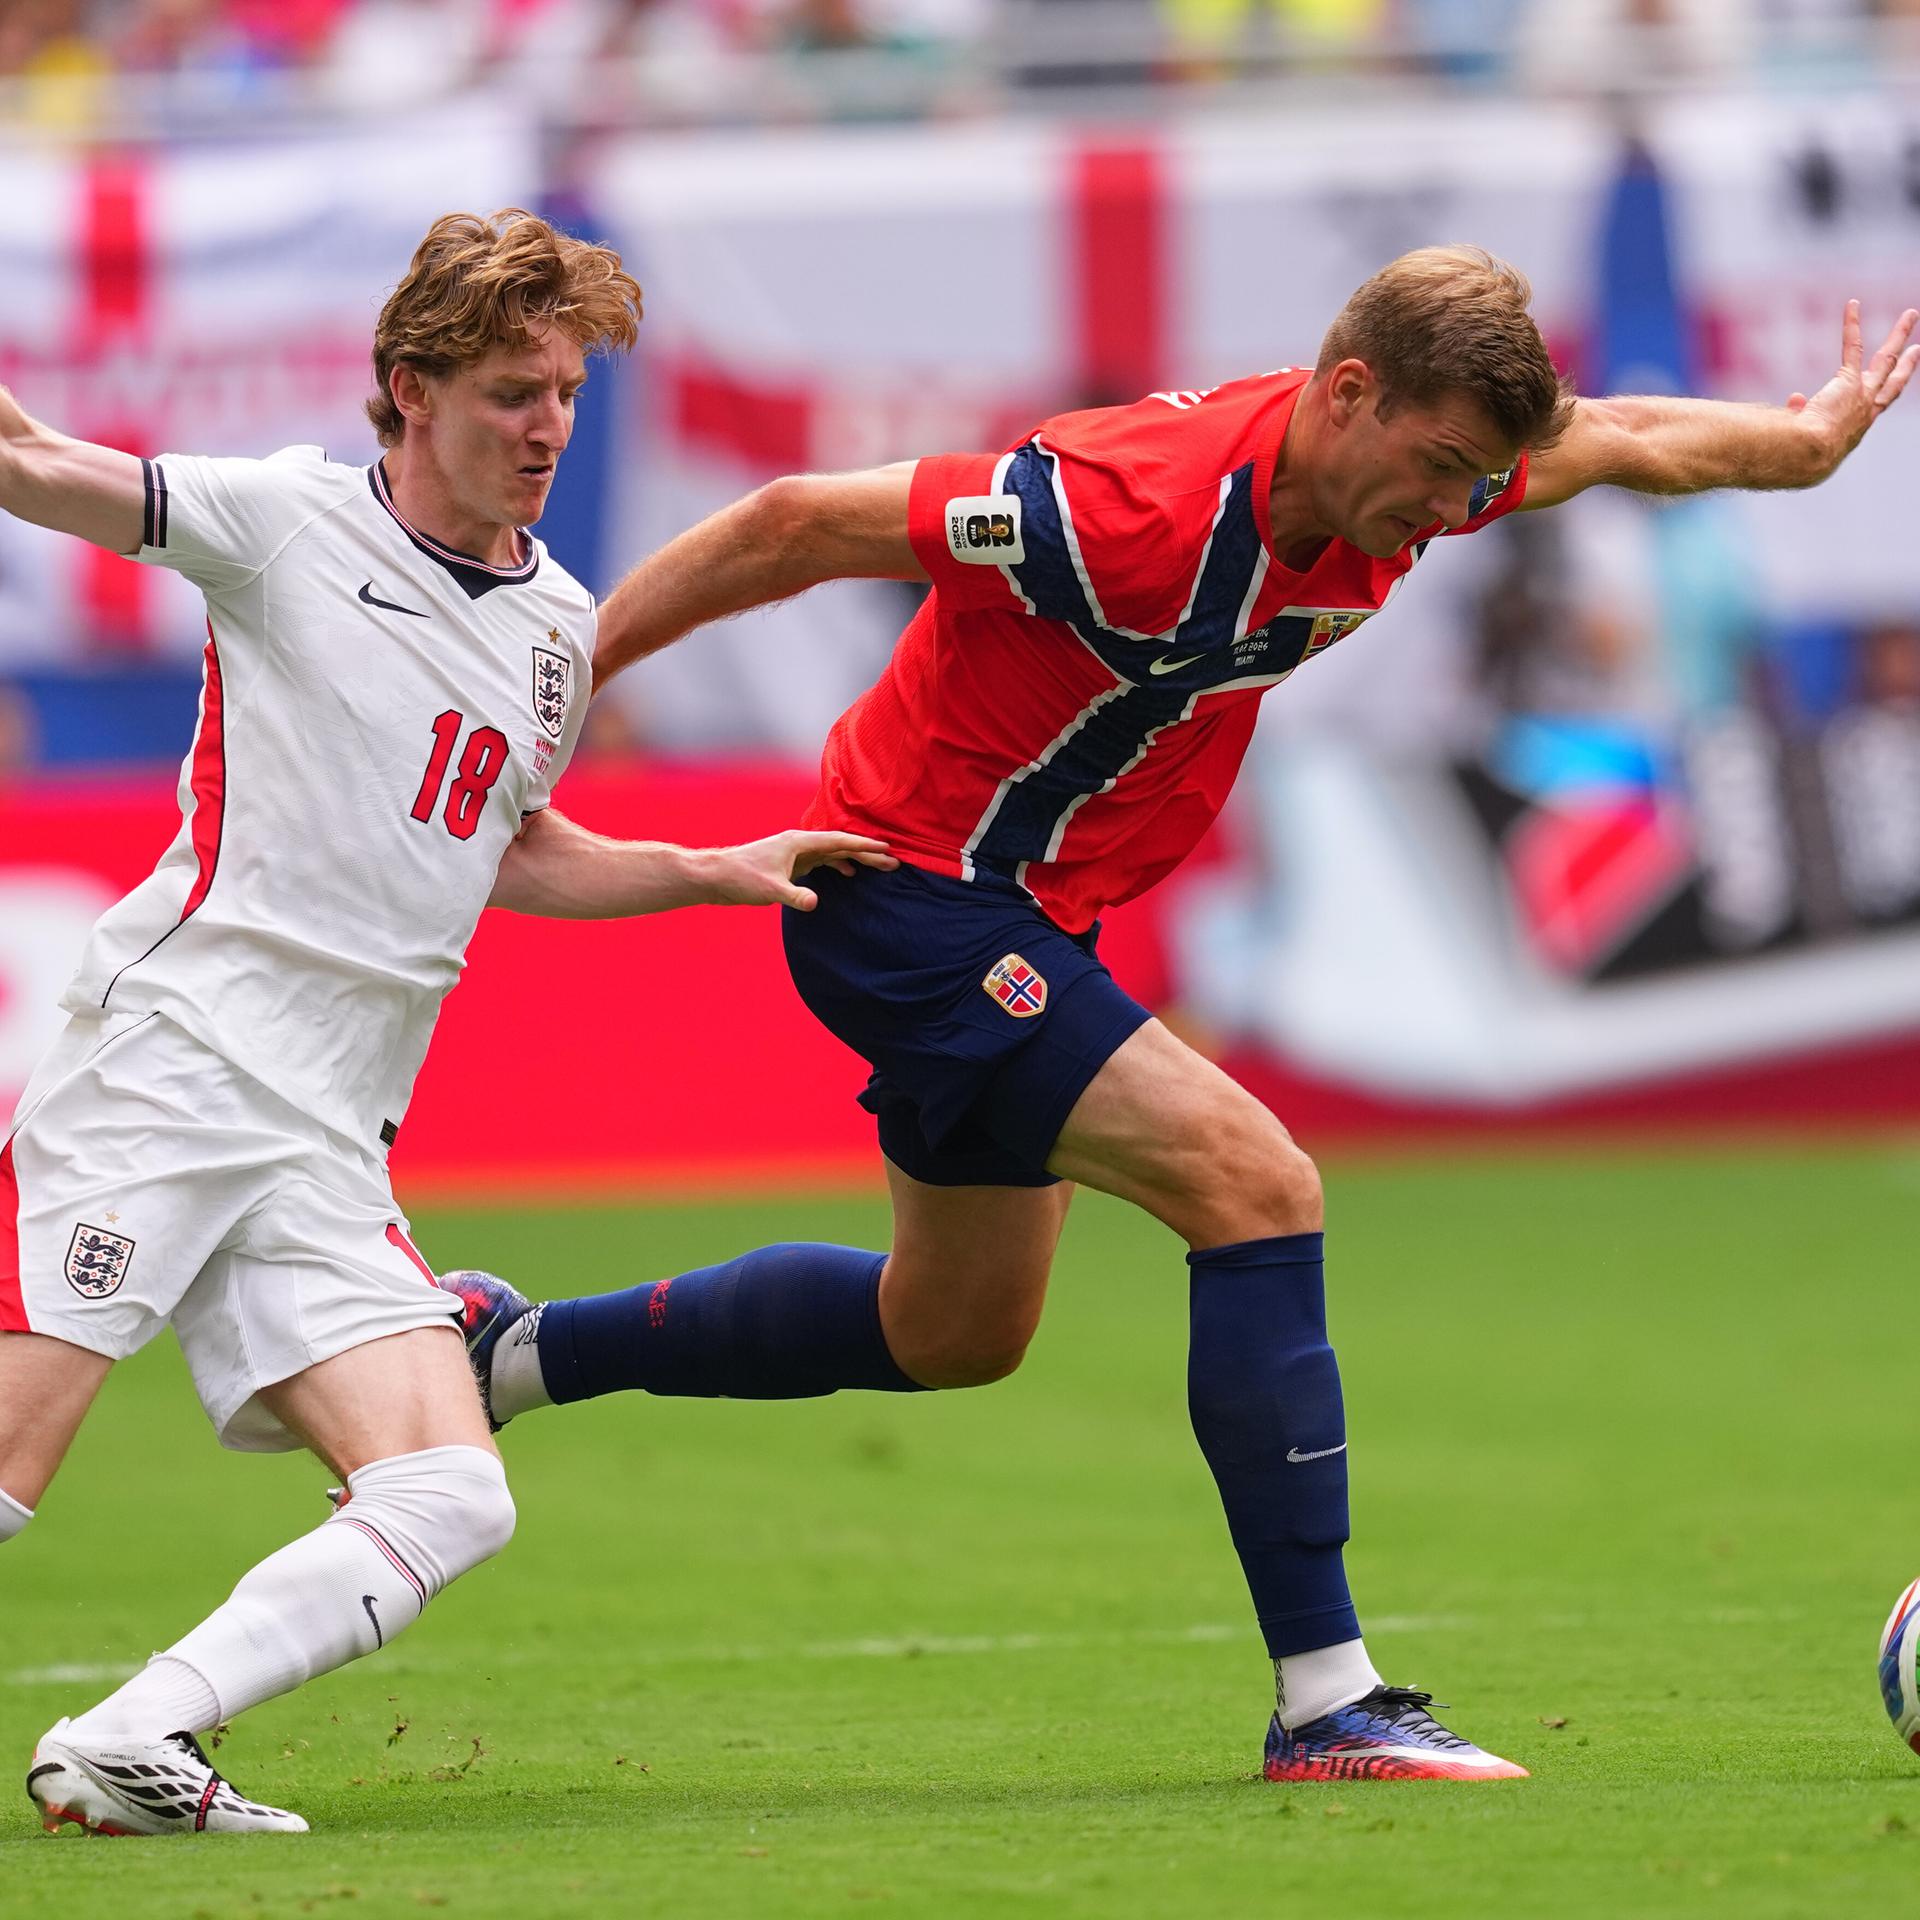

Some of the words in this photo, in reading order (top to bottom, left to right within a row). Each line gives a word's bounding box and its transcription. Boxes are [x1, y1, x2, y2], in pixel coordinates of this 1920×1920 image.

[951, 516, 962, 549] 2026
[410, 709, 510, 841] 18
[99, 1752, 136, 1761] ANTONELLO
